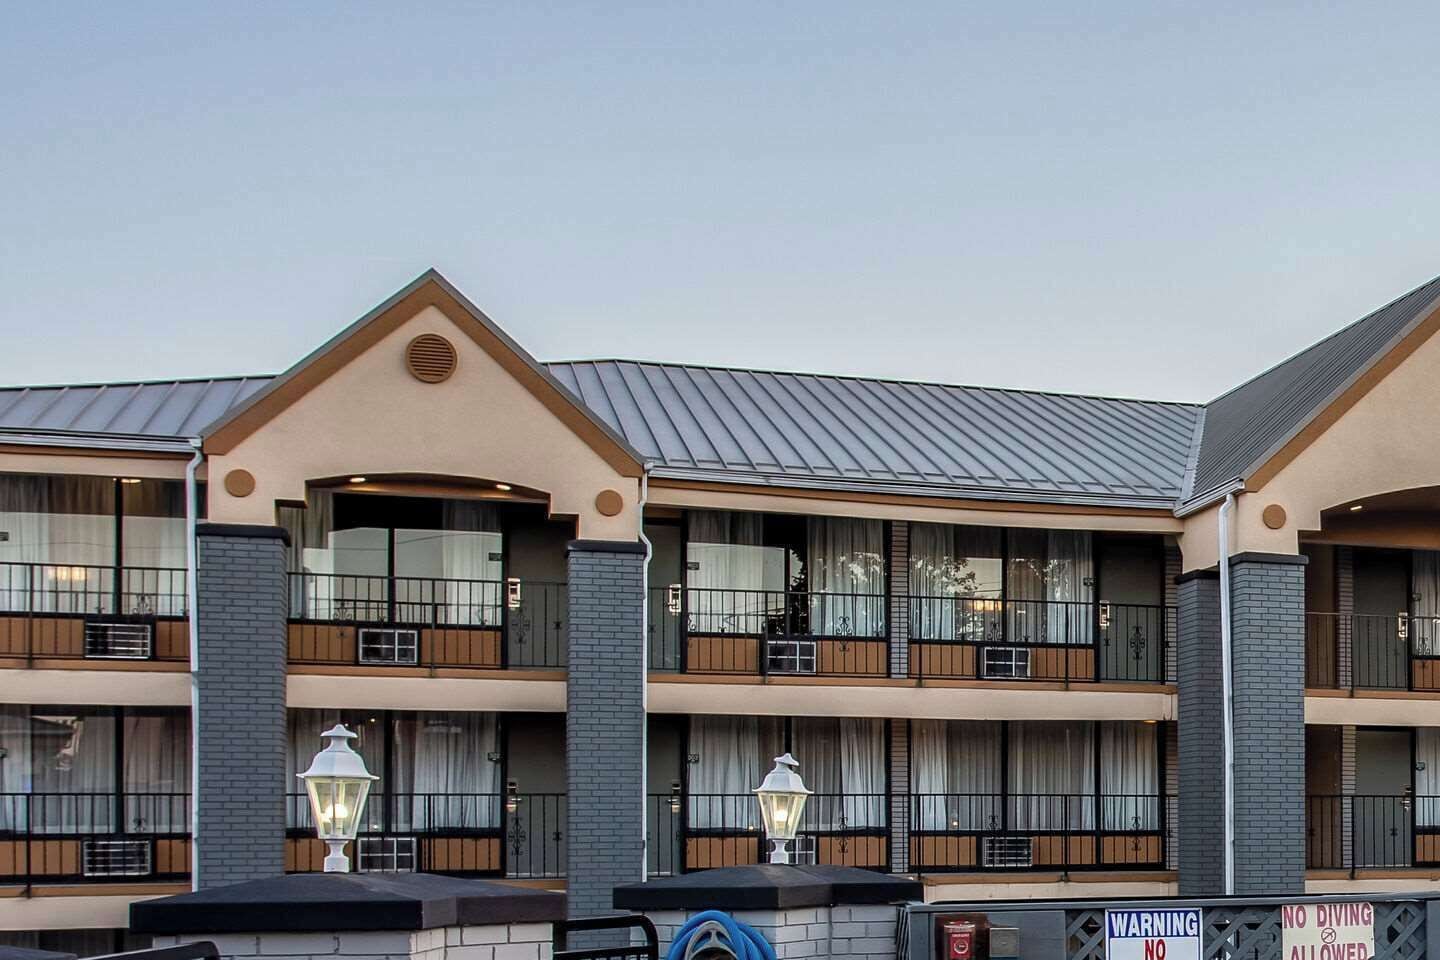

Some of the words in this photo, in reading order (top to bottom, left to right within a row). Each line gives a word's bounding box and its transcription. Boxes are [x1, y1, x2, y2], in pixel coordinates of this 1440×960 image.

[1110, 912, 1198, 936] WARNING
[1283, 904, 1306, 928] NO
[1316, 903, 1372, 927] DIVING
